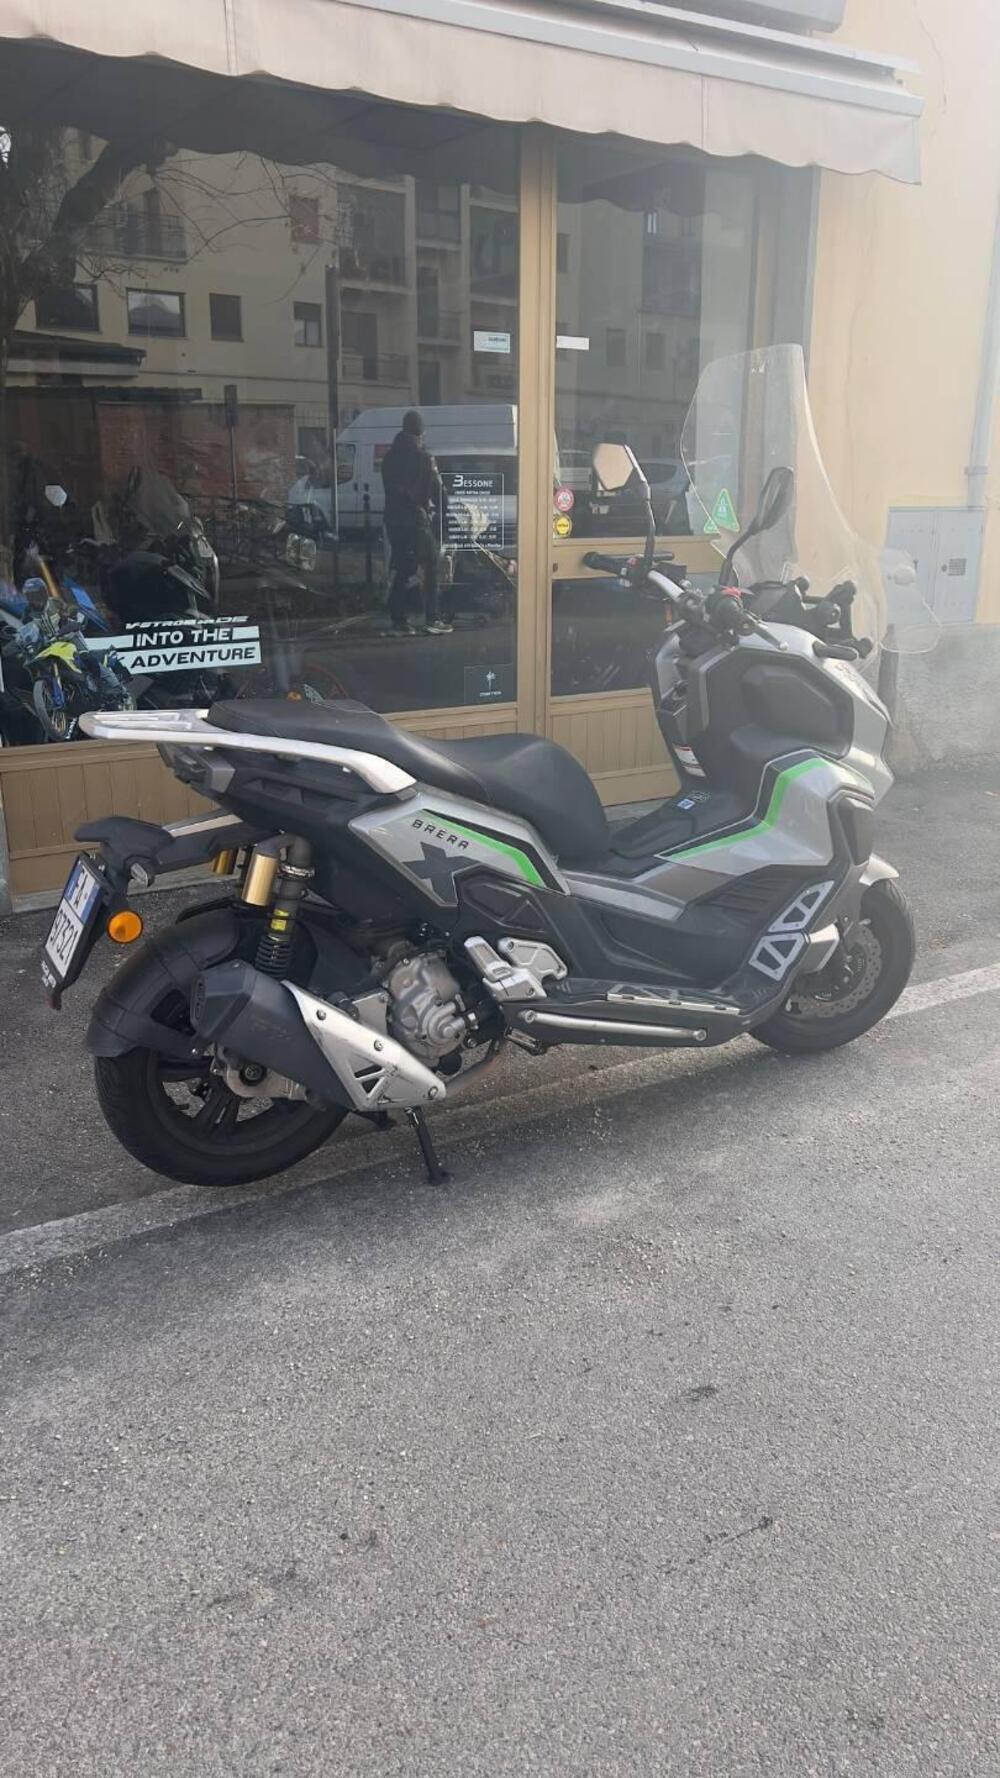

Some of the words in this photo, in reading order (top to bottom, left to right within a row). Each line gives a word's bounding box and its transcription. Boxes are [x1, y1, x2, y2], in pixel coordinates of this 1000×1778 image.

[136, 631, 184, 647] INTO
[191, 627, 231, 643] THE
[130, 646, 256, 669] ADVENTURE
[411, 818, 470, 850] BRERA
